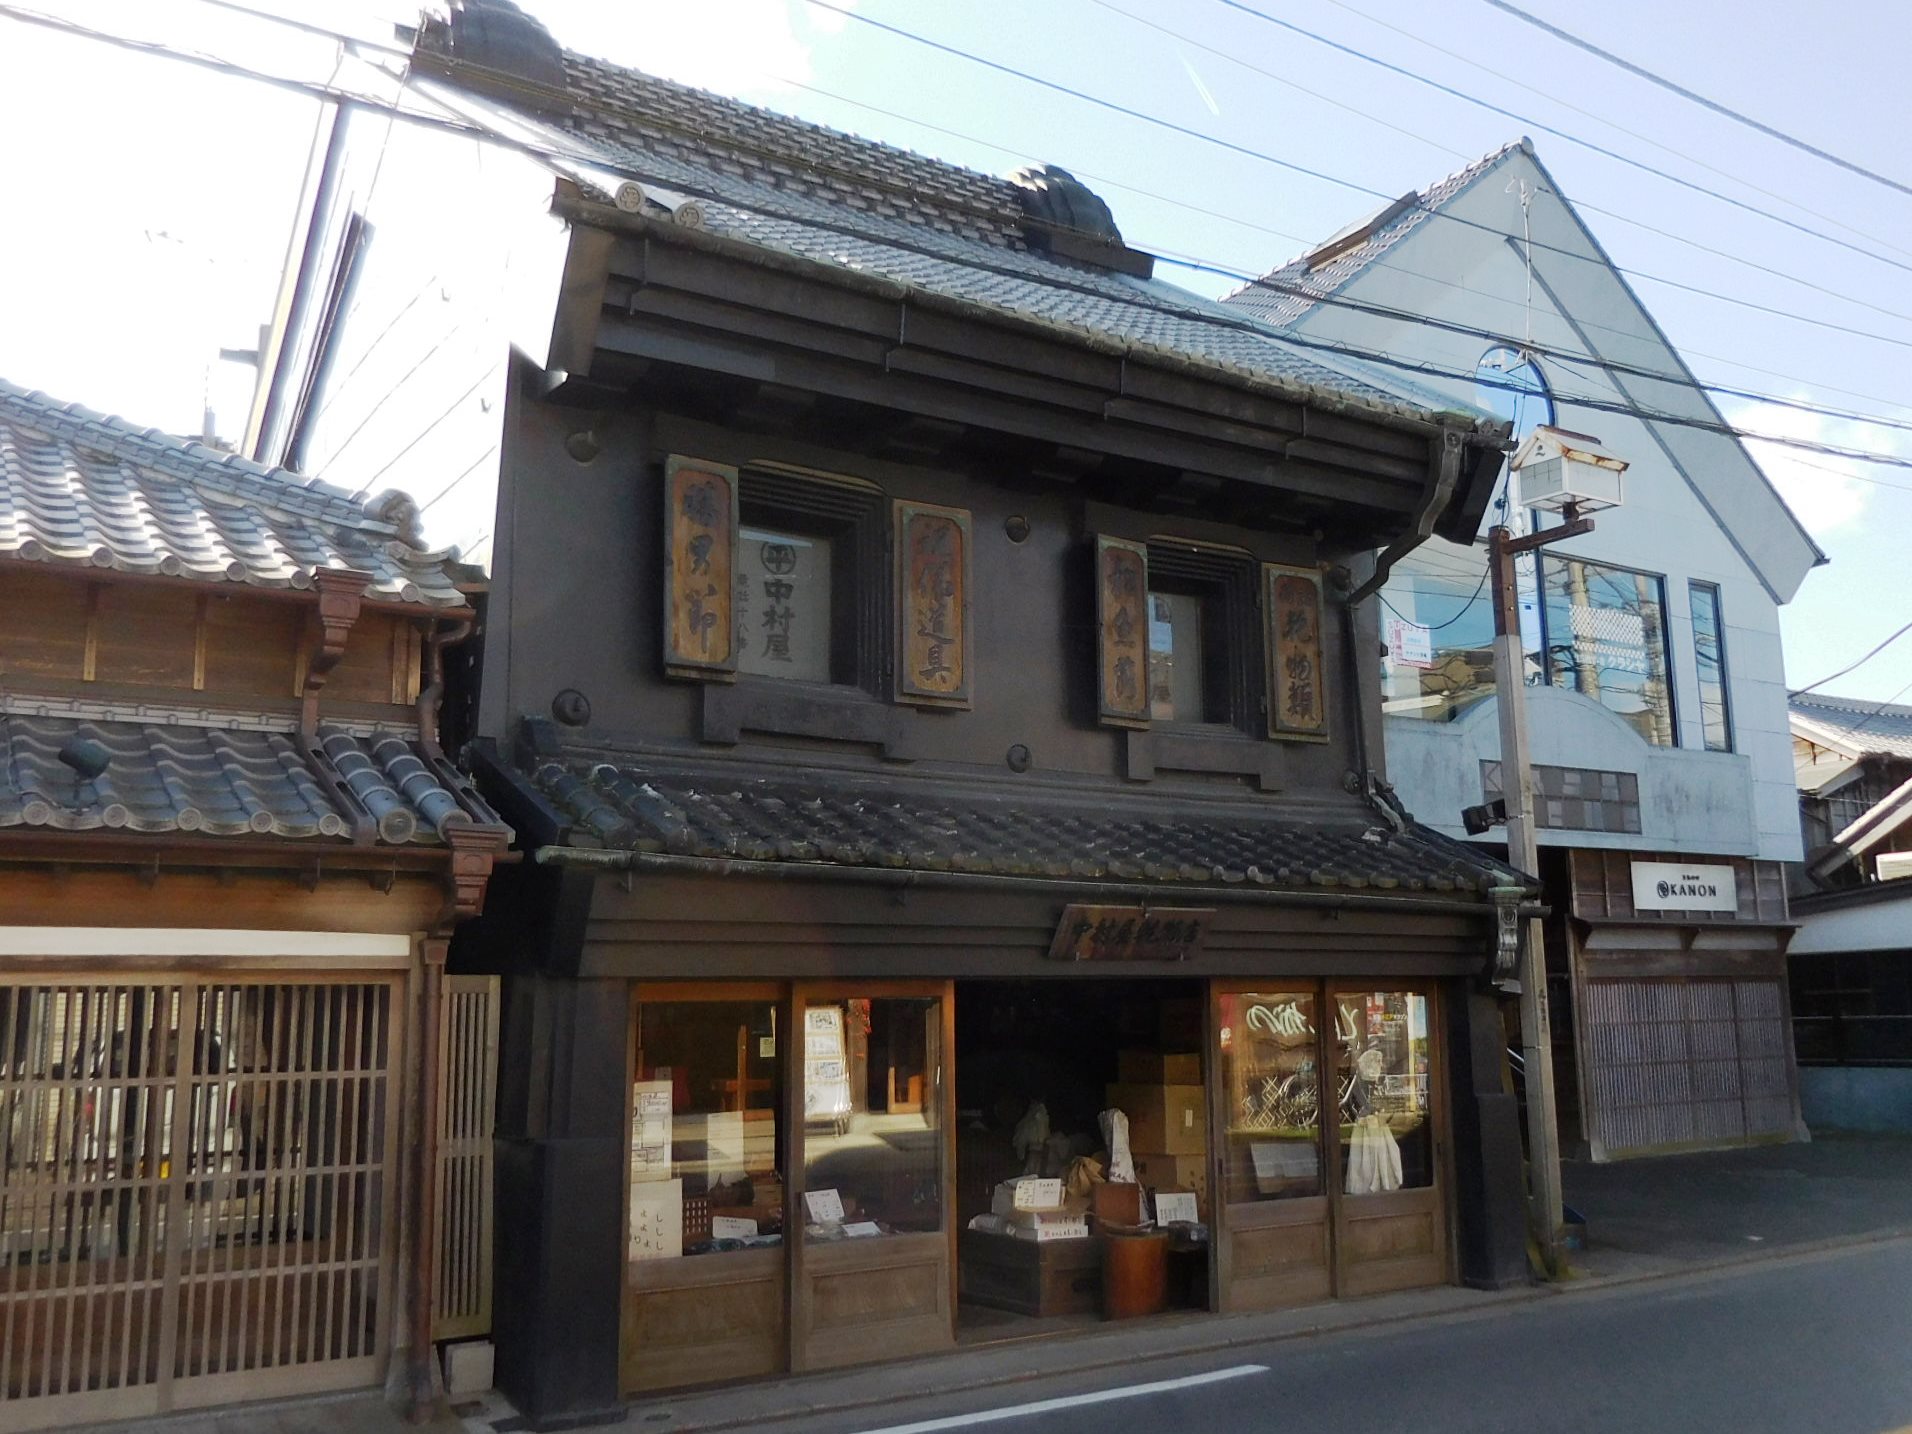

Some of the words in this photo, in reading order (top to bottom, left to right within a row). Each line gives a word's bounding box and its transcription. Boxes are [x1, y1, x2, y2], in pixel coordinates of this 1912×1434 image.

[761, 578, 795, 663] 中村屋
[1670, 883, 1717, 897] KANON
